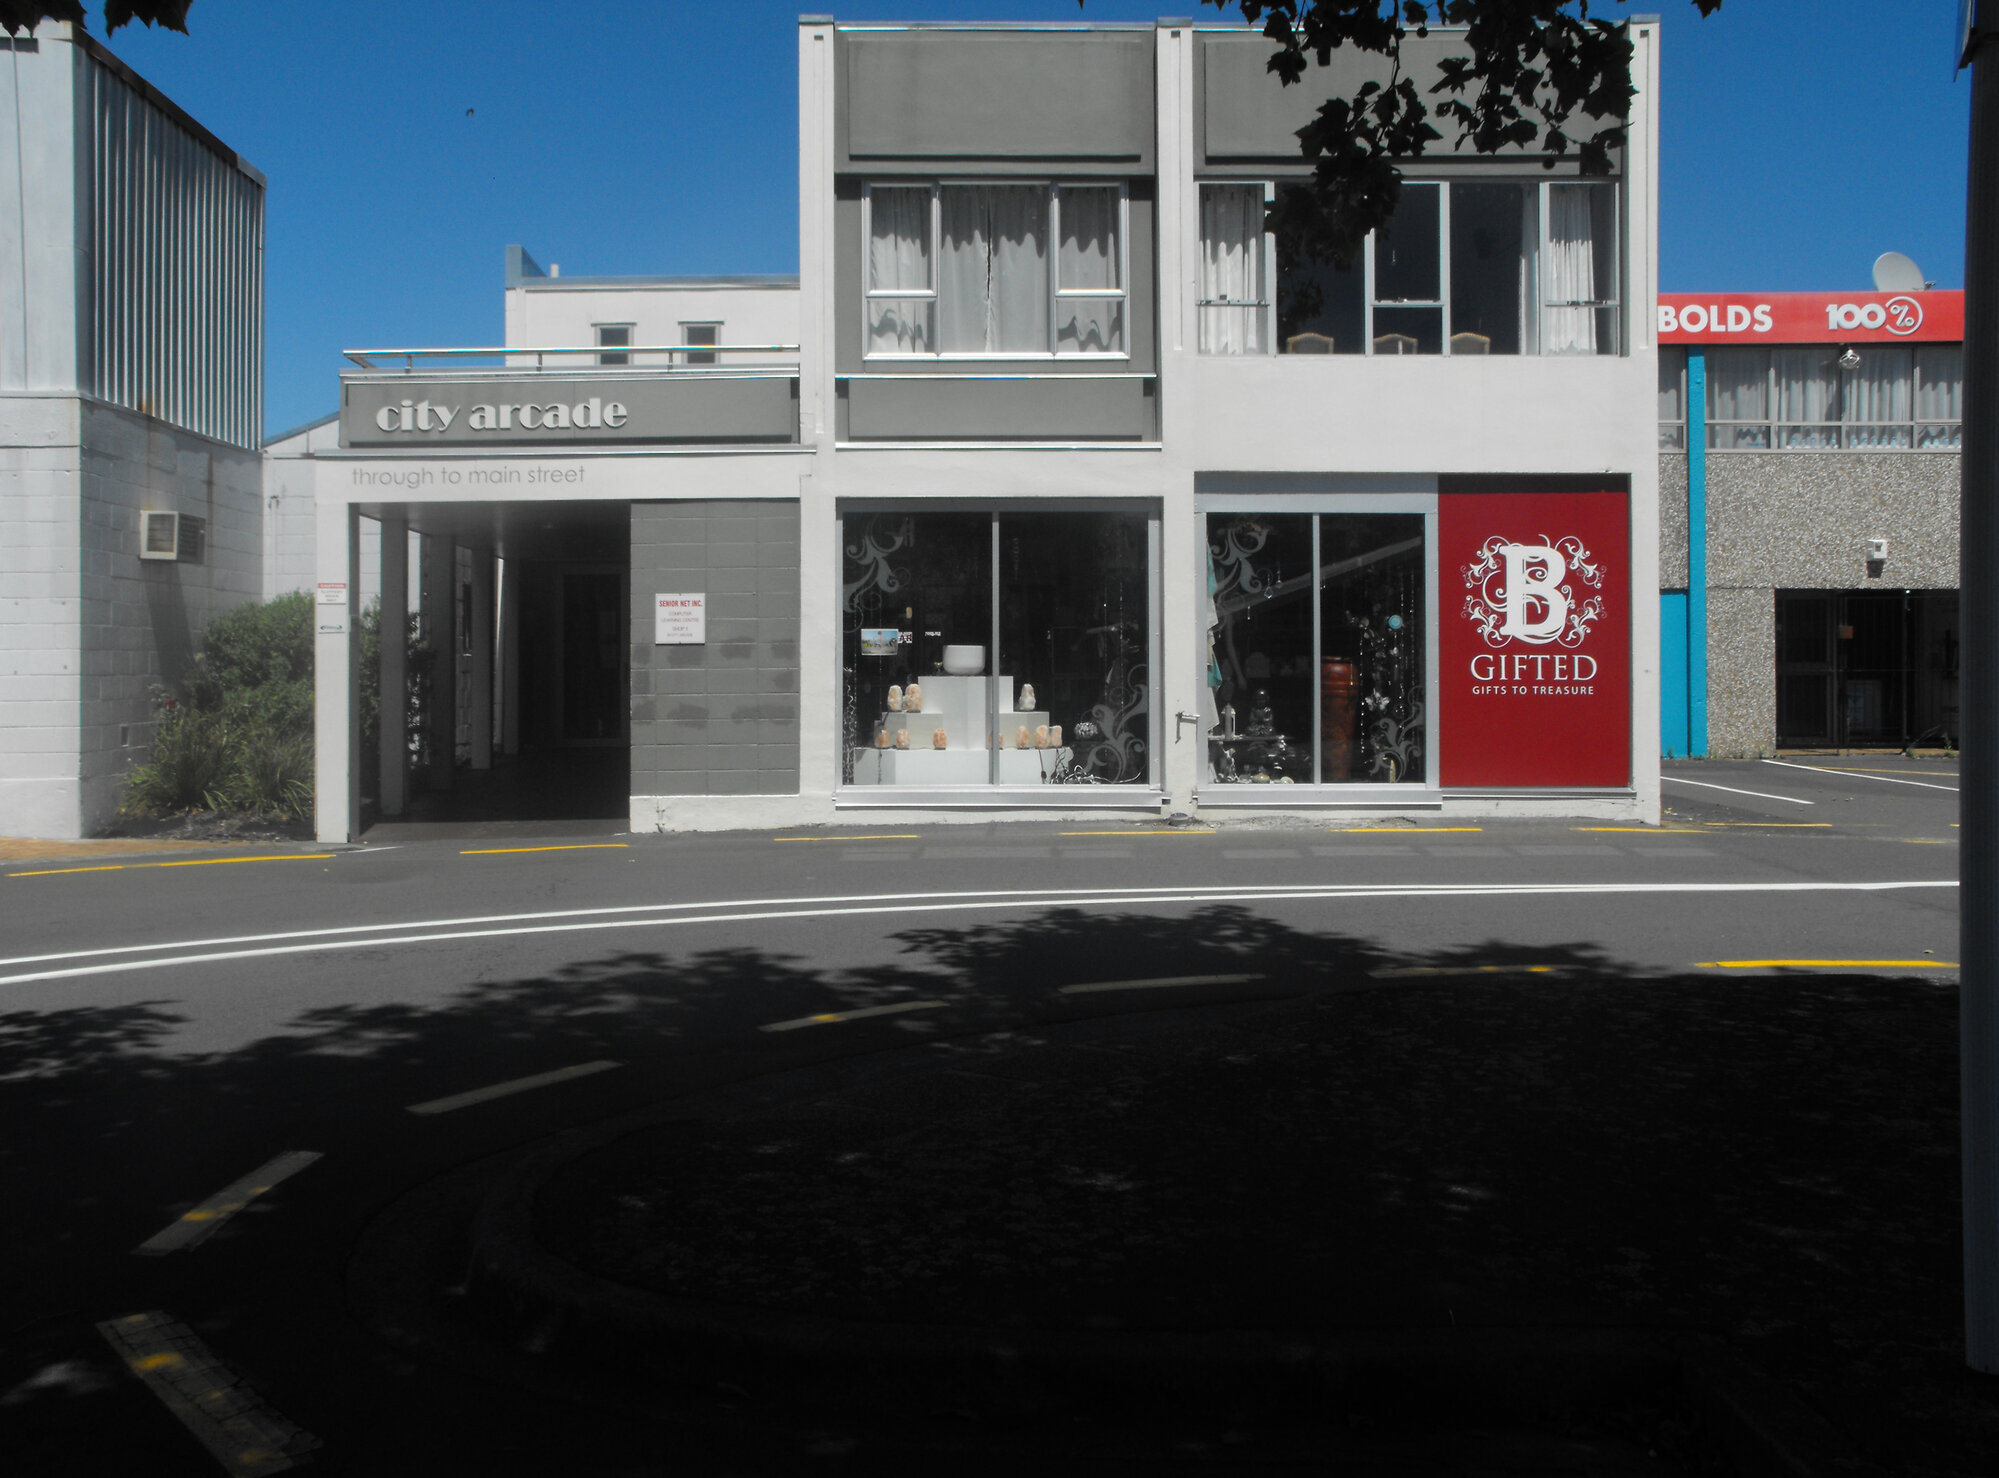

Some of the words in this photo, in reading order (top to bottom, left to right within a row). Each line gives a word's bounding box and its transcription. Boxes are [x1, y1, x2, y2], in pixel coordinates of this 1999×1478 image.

[376, 399, 461, 433] city
[468, 397, 629, 430] arcade
[353, 467, 434, 489] through
[441, 466, 463, 485] to
[468, 465, 521, 484] main
[527, 465, 586, 484] street
[1470, 654, 1598, 681] GIFTED
[1472, 685, 1507, 695] GIFTS
[1512, 685, 1528, 695] TO
[1533, 685, 1595, 695] TREASURE
